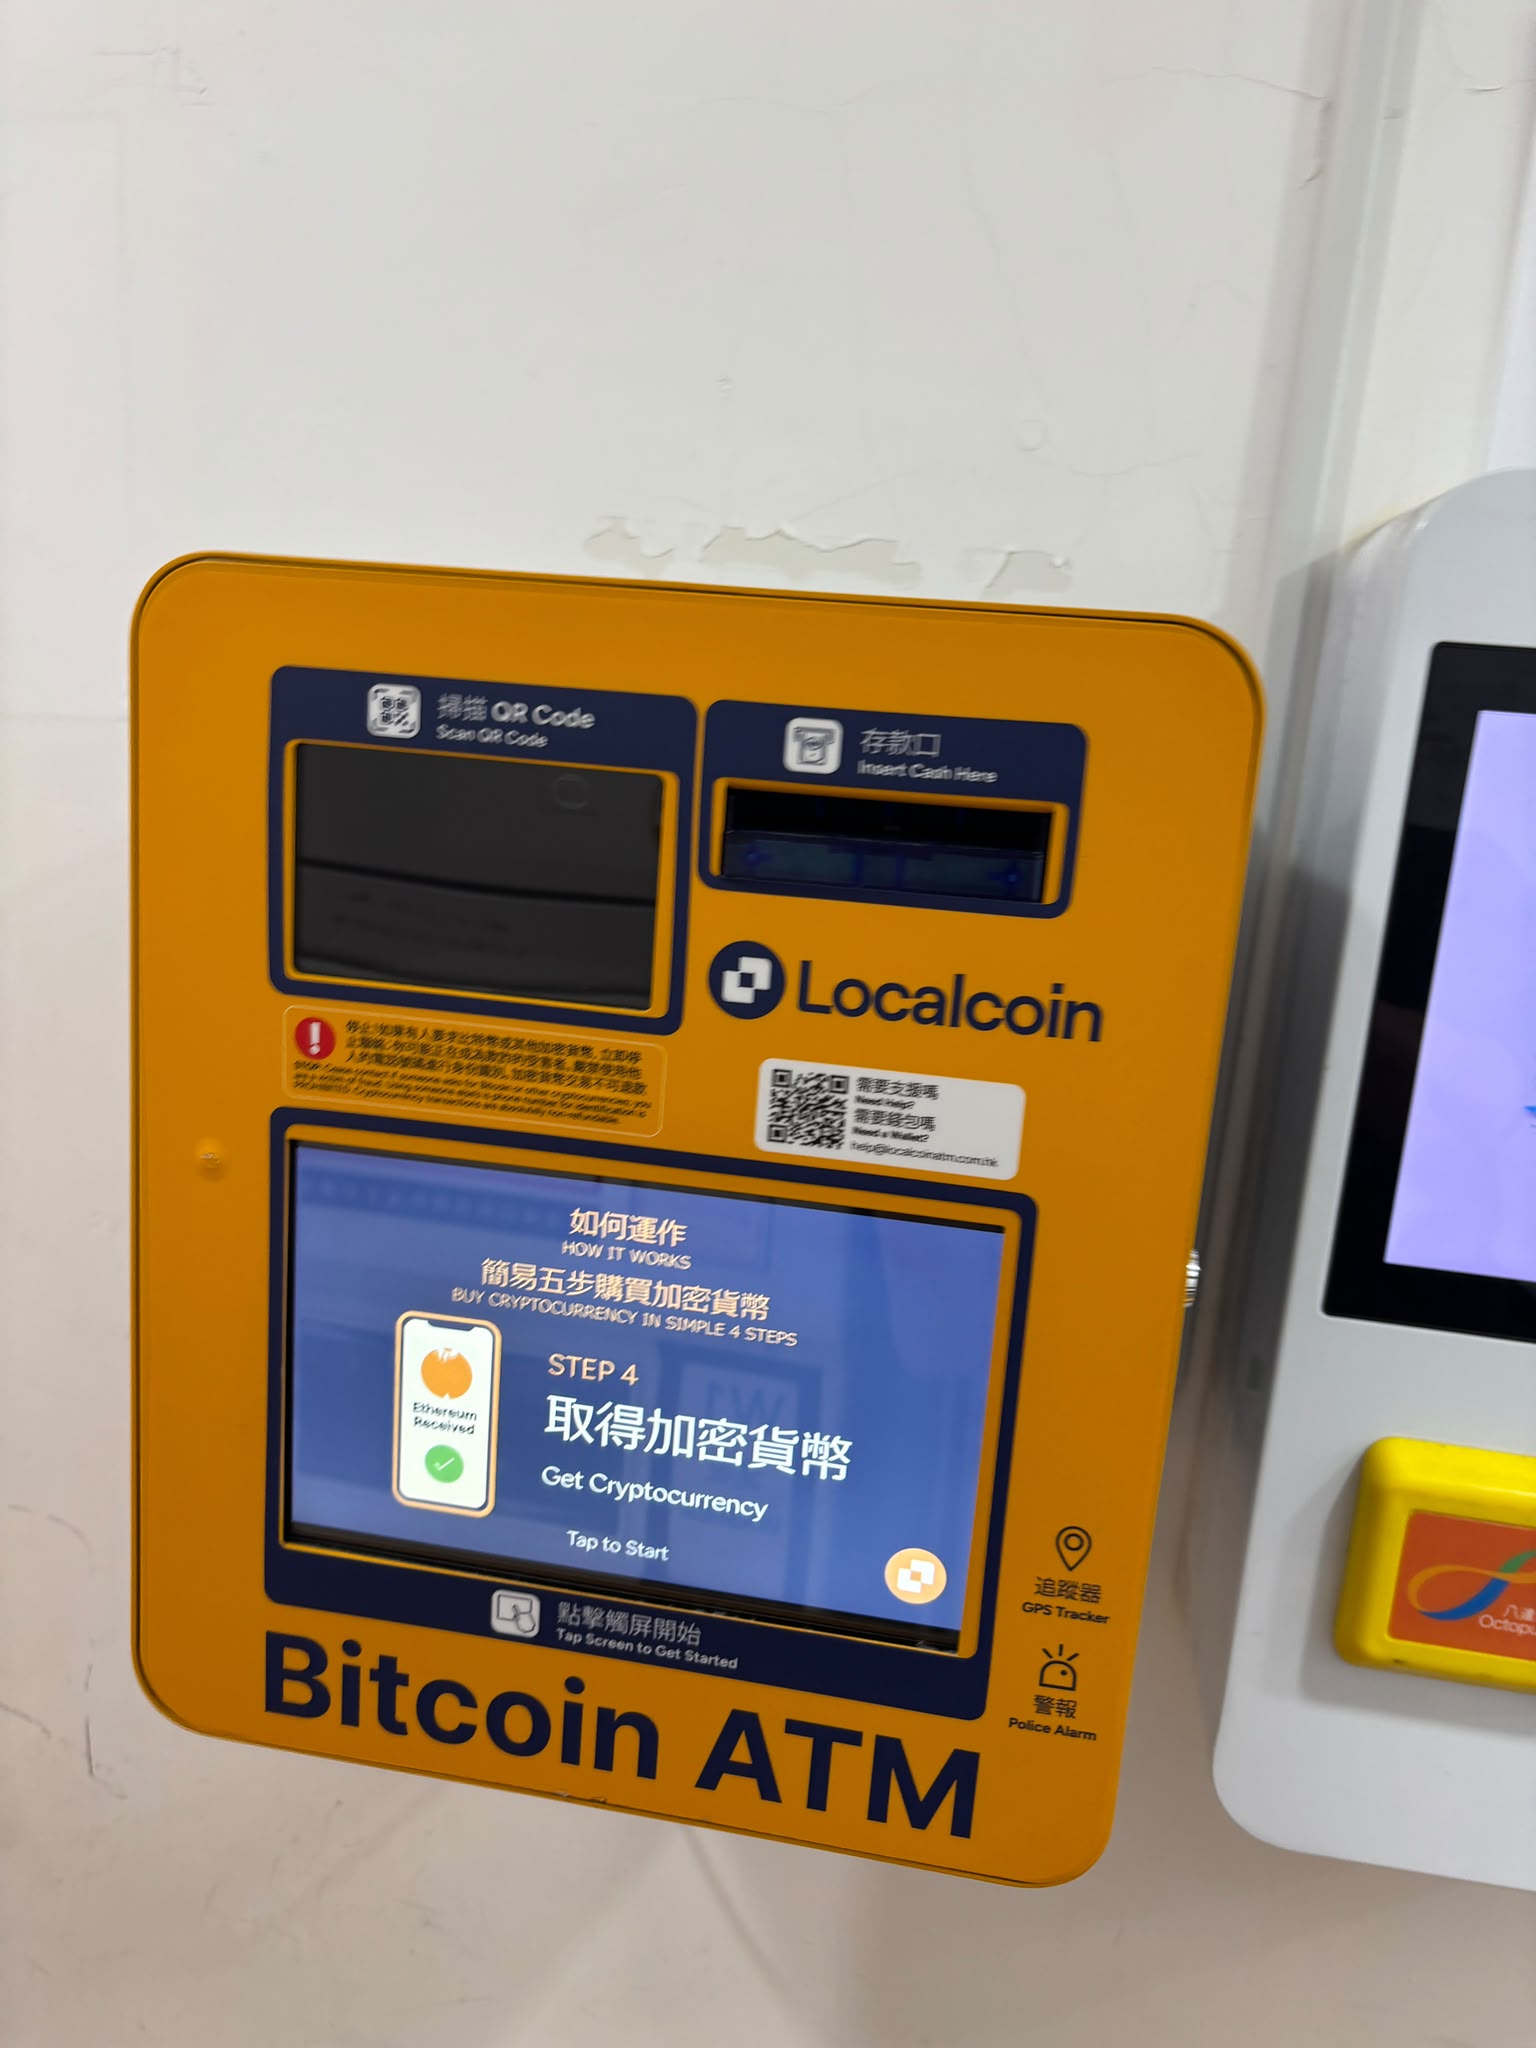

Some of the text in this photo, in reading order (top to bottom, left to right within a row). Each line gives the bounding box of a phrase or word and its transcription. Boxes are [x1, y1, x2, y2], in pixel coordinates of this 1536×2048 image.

[491, 701, 528, 723] QR
[531, 704, 596, 729] Code
[436, 723, 548, 748] Scan QR Code
[859, 727, 942, 758] 存款口
[857, 759, 999, 783] Insert Cash Here
[798, 959, 1104, 1043] Localcoin
[855, 1076, 940, 1100] 需要支援嗎
[568, 1207, 688, 1248] 如何運作
[561, 1240, 692, 1270] HOW IT WORKS
[481, 1257, 771, 1321] 簡易五步購買加密貨幣
[451, 1287, 799, 1347] BUY CRYPTOCURRENCY IN SIMPLE 4 STEPS
[547, 1353, 640, 1387] STEP 4
[413, 1401, 478, 1421] Ethereum
[413, 1416, 476, 1435] Received
[544, 1394, 853, 1481] 取得加密貨幣
[541, 1465, 769, 1523] Get Cryptocurrency
[566, 1529, 670, 1562] Tap to Start
[1034, 1576, 1102, 1604] 追蹤器
[557, 1601, 702, 1647] 點擊觸屏開始
[1021, 1601, 1111, 1624] GPS Tracker
[556, 1627, 739, 1670] Tap Screen to Get Started
[1033, 1694, 1078, 1720] 警報
[264, 1629, 982, 1840] Bitcoin ATM
[1008, 1717, 1098, 1742] Police Alarm
